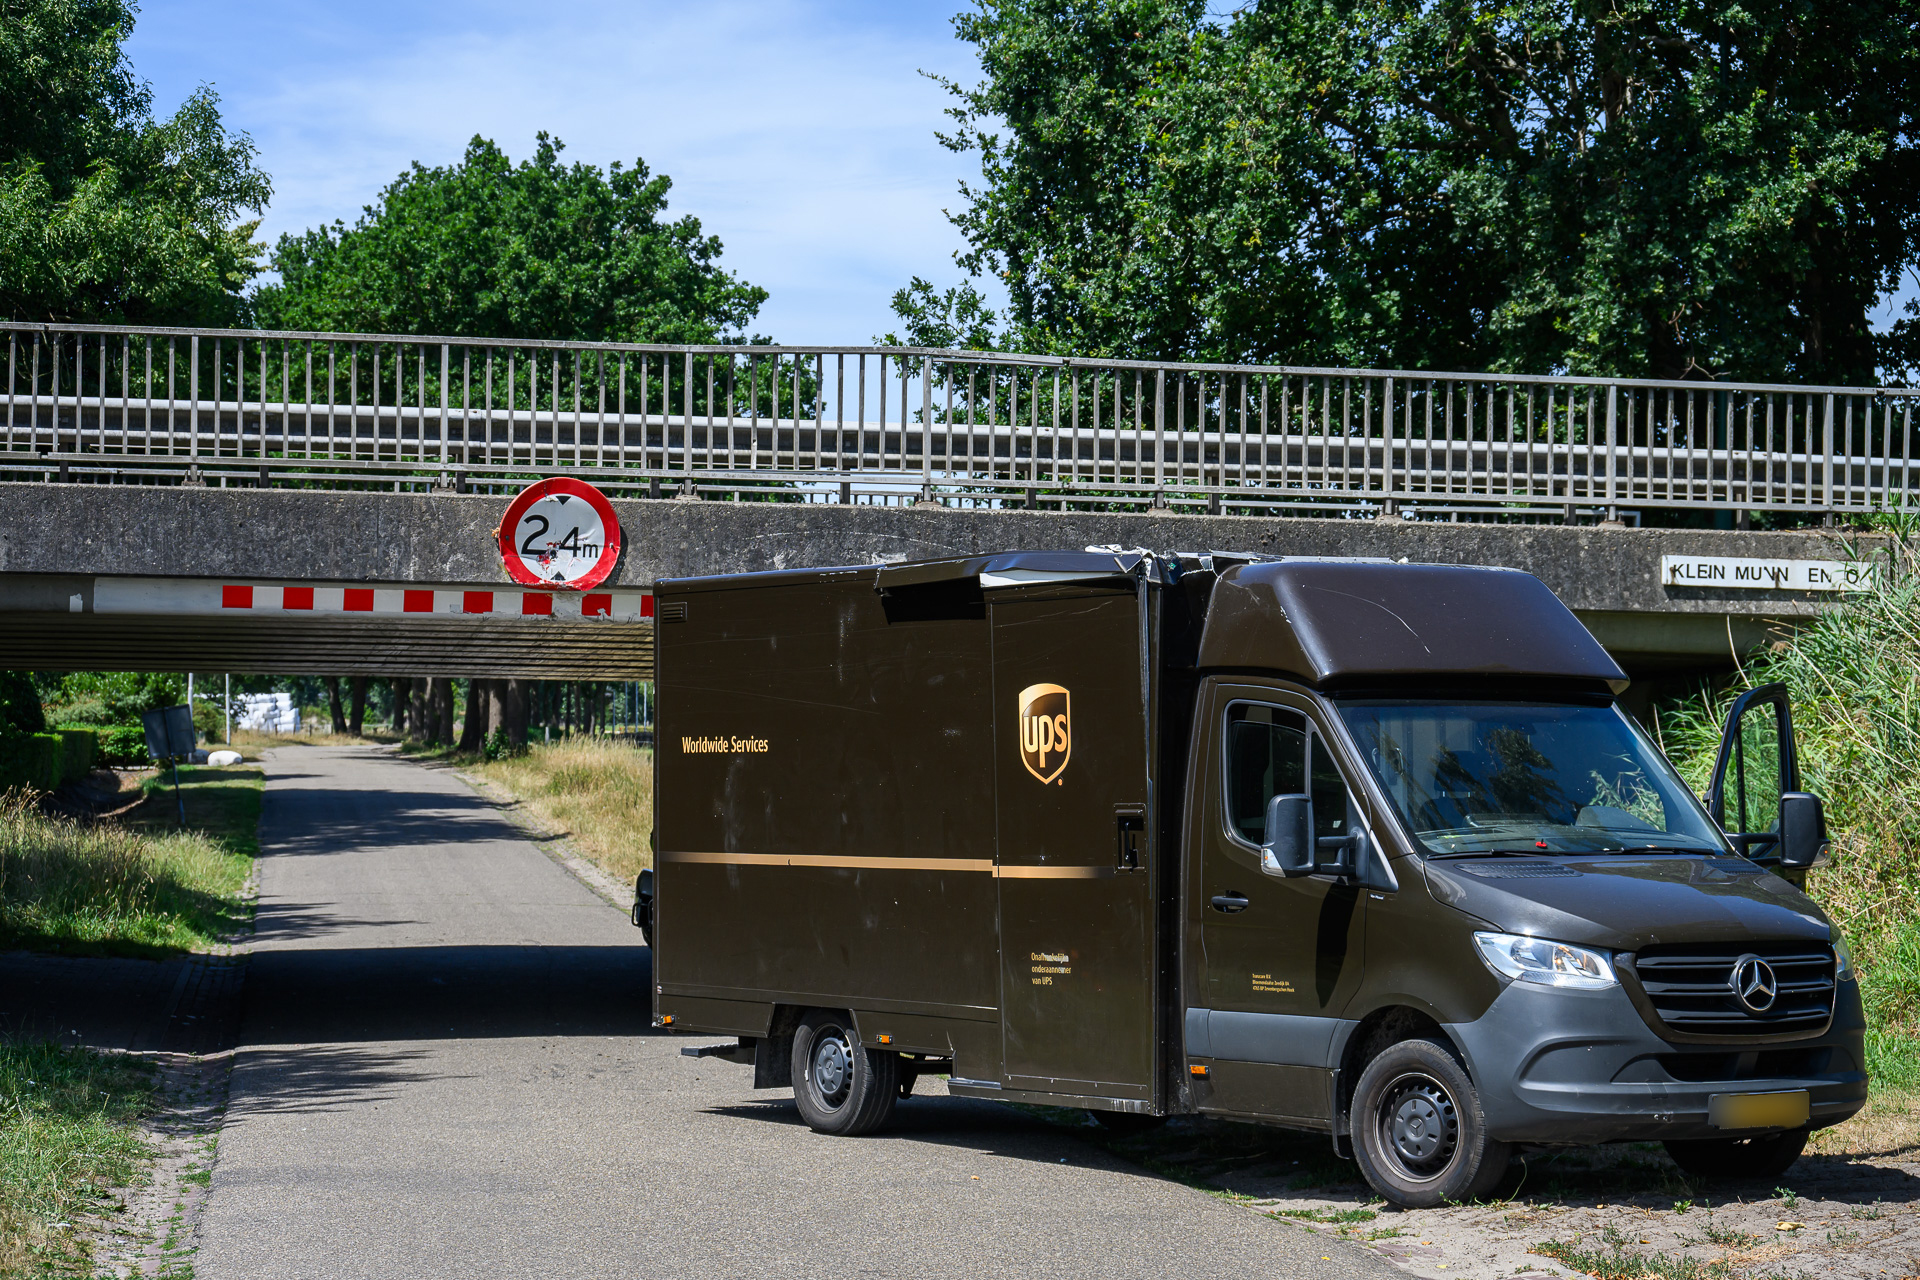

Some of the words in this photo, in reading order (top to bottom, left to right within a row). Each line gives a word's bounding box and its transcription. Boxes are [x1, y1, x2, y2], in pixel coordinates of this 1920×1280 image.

[1672, 563, 1726, 580] KLEIN
[681, 735, 729, 754] Worldwide
[730, 735, 769, 753] Services
[1023, 713, 1068, 769] ups
[1031, 977, 1042, 985] van
[1042, 976, 1053, 986] UPS
